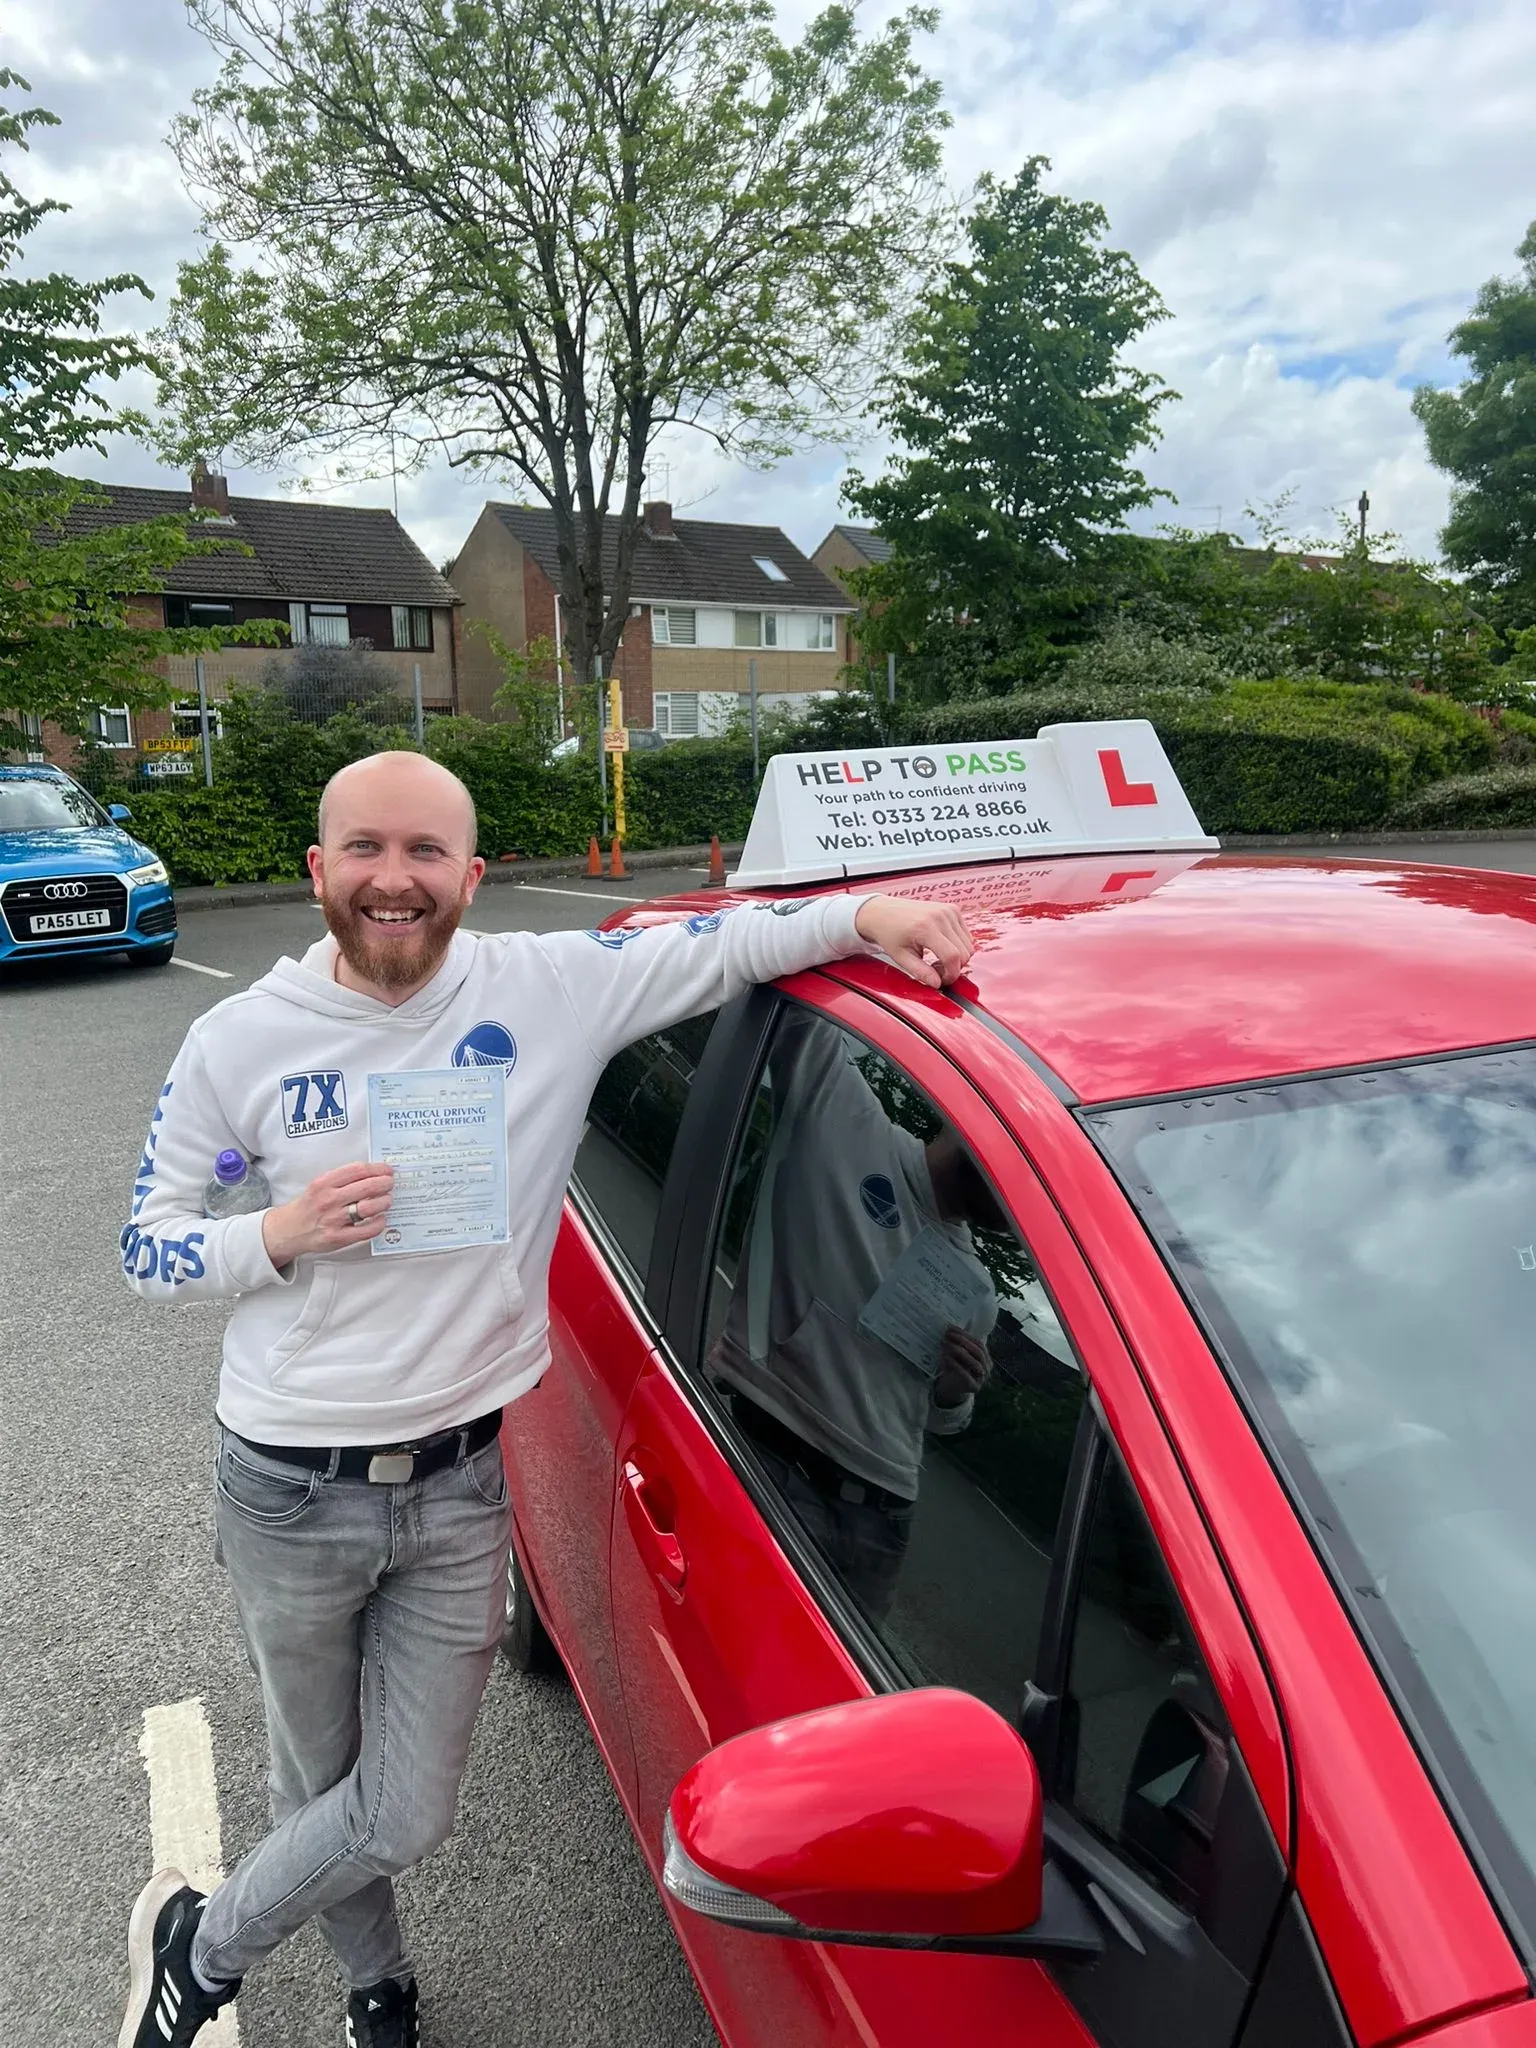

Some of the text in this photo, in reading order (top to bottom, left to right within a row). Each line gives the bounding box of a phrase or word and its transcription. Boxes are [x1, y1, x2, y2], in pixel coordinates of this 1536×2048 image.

[175, 763, 191, 772] AGY
[796, 750, 1027, 786] HELP TO PASS
[1098, 750, 1158, 807] L
[814, 781, 1027, 805] Your path to confident driving
[827, 800, 1027, 828] Tel: 0333 224 8866
[816, 818, 1052, 850] Web: helptopass.co.uk
[36, 911, 103, 930] PA55 LET
[283, 1074, 344, 1123] 7X
[287, 1116, 346, 1134] CHAMPIONS
[388, 1106, 486, 1120] PRACTICAL DRIVING
[388, 1115, 486, 1129] TEST PASS CERTIFICATE
